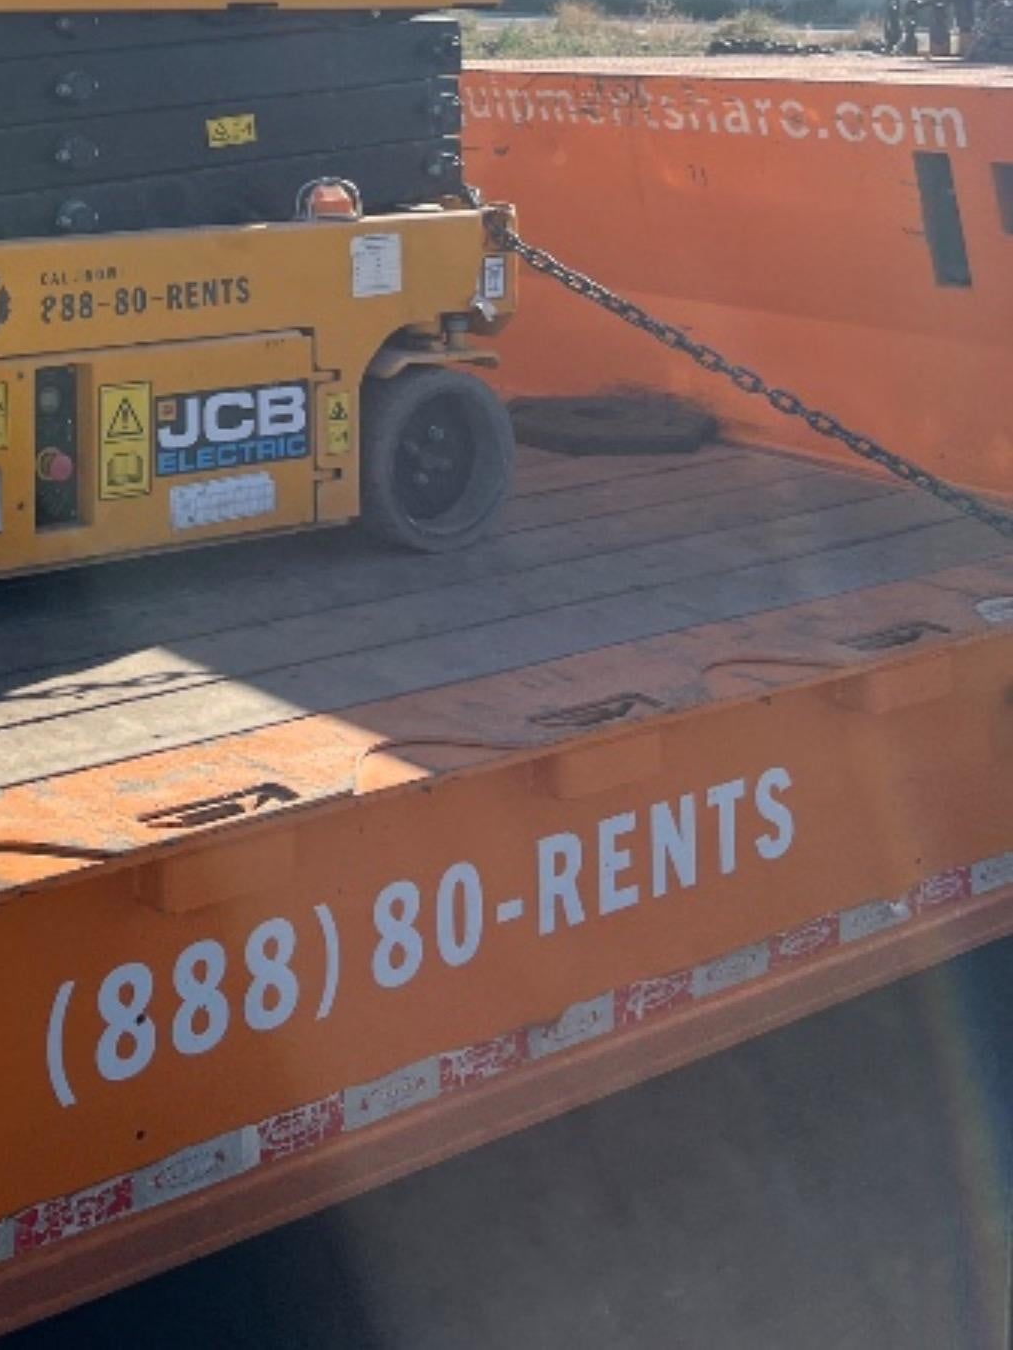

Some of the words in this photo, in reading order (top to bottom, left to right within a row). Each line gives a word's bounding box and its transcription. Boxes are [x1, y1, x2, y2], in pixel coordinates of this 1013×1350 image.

[461, 80, 969, 148] uipmentshare.com
[157, 385, 307, 449] JCB
[157, 434, 307, 476] ELECTRIC
[46, 903, 340, 1108] (888)
[372, 766, 795, 988] 80-RENTS
